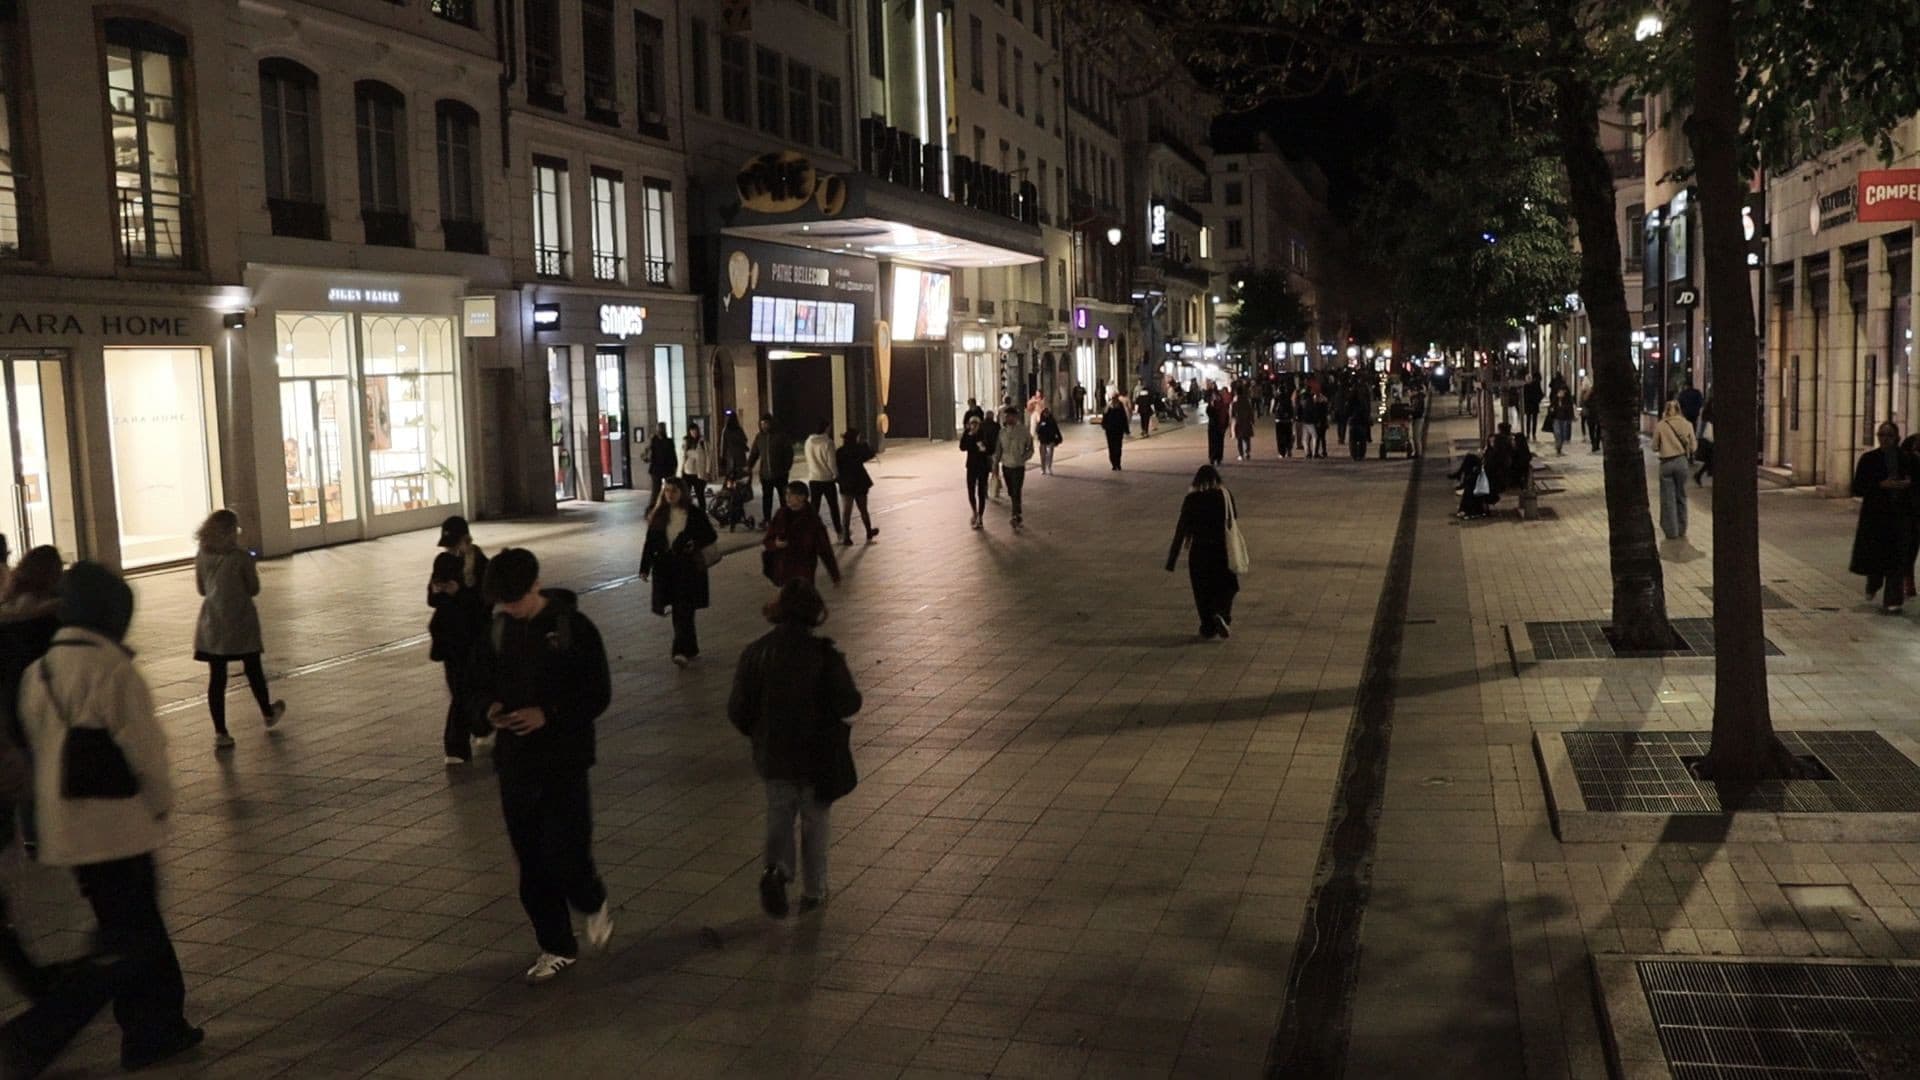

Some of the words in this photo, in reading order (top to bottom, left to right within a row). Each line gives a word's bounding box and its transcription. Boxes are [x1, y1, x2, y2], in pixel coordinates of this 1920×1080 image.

[793, 265, 830, 287] BELLECO
[1675, 291, 1695, 305] JD
[101, 315, 192, 337] HOME
